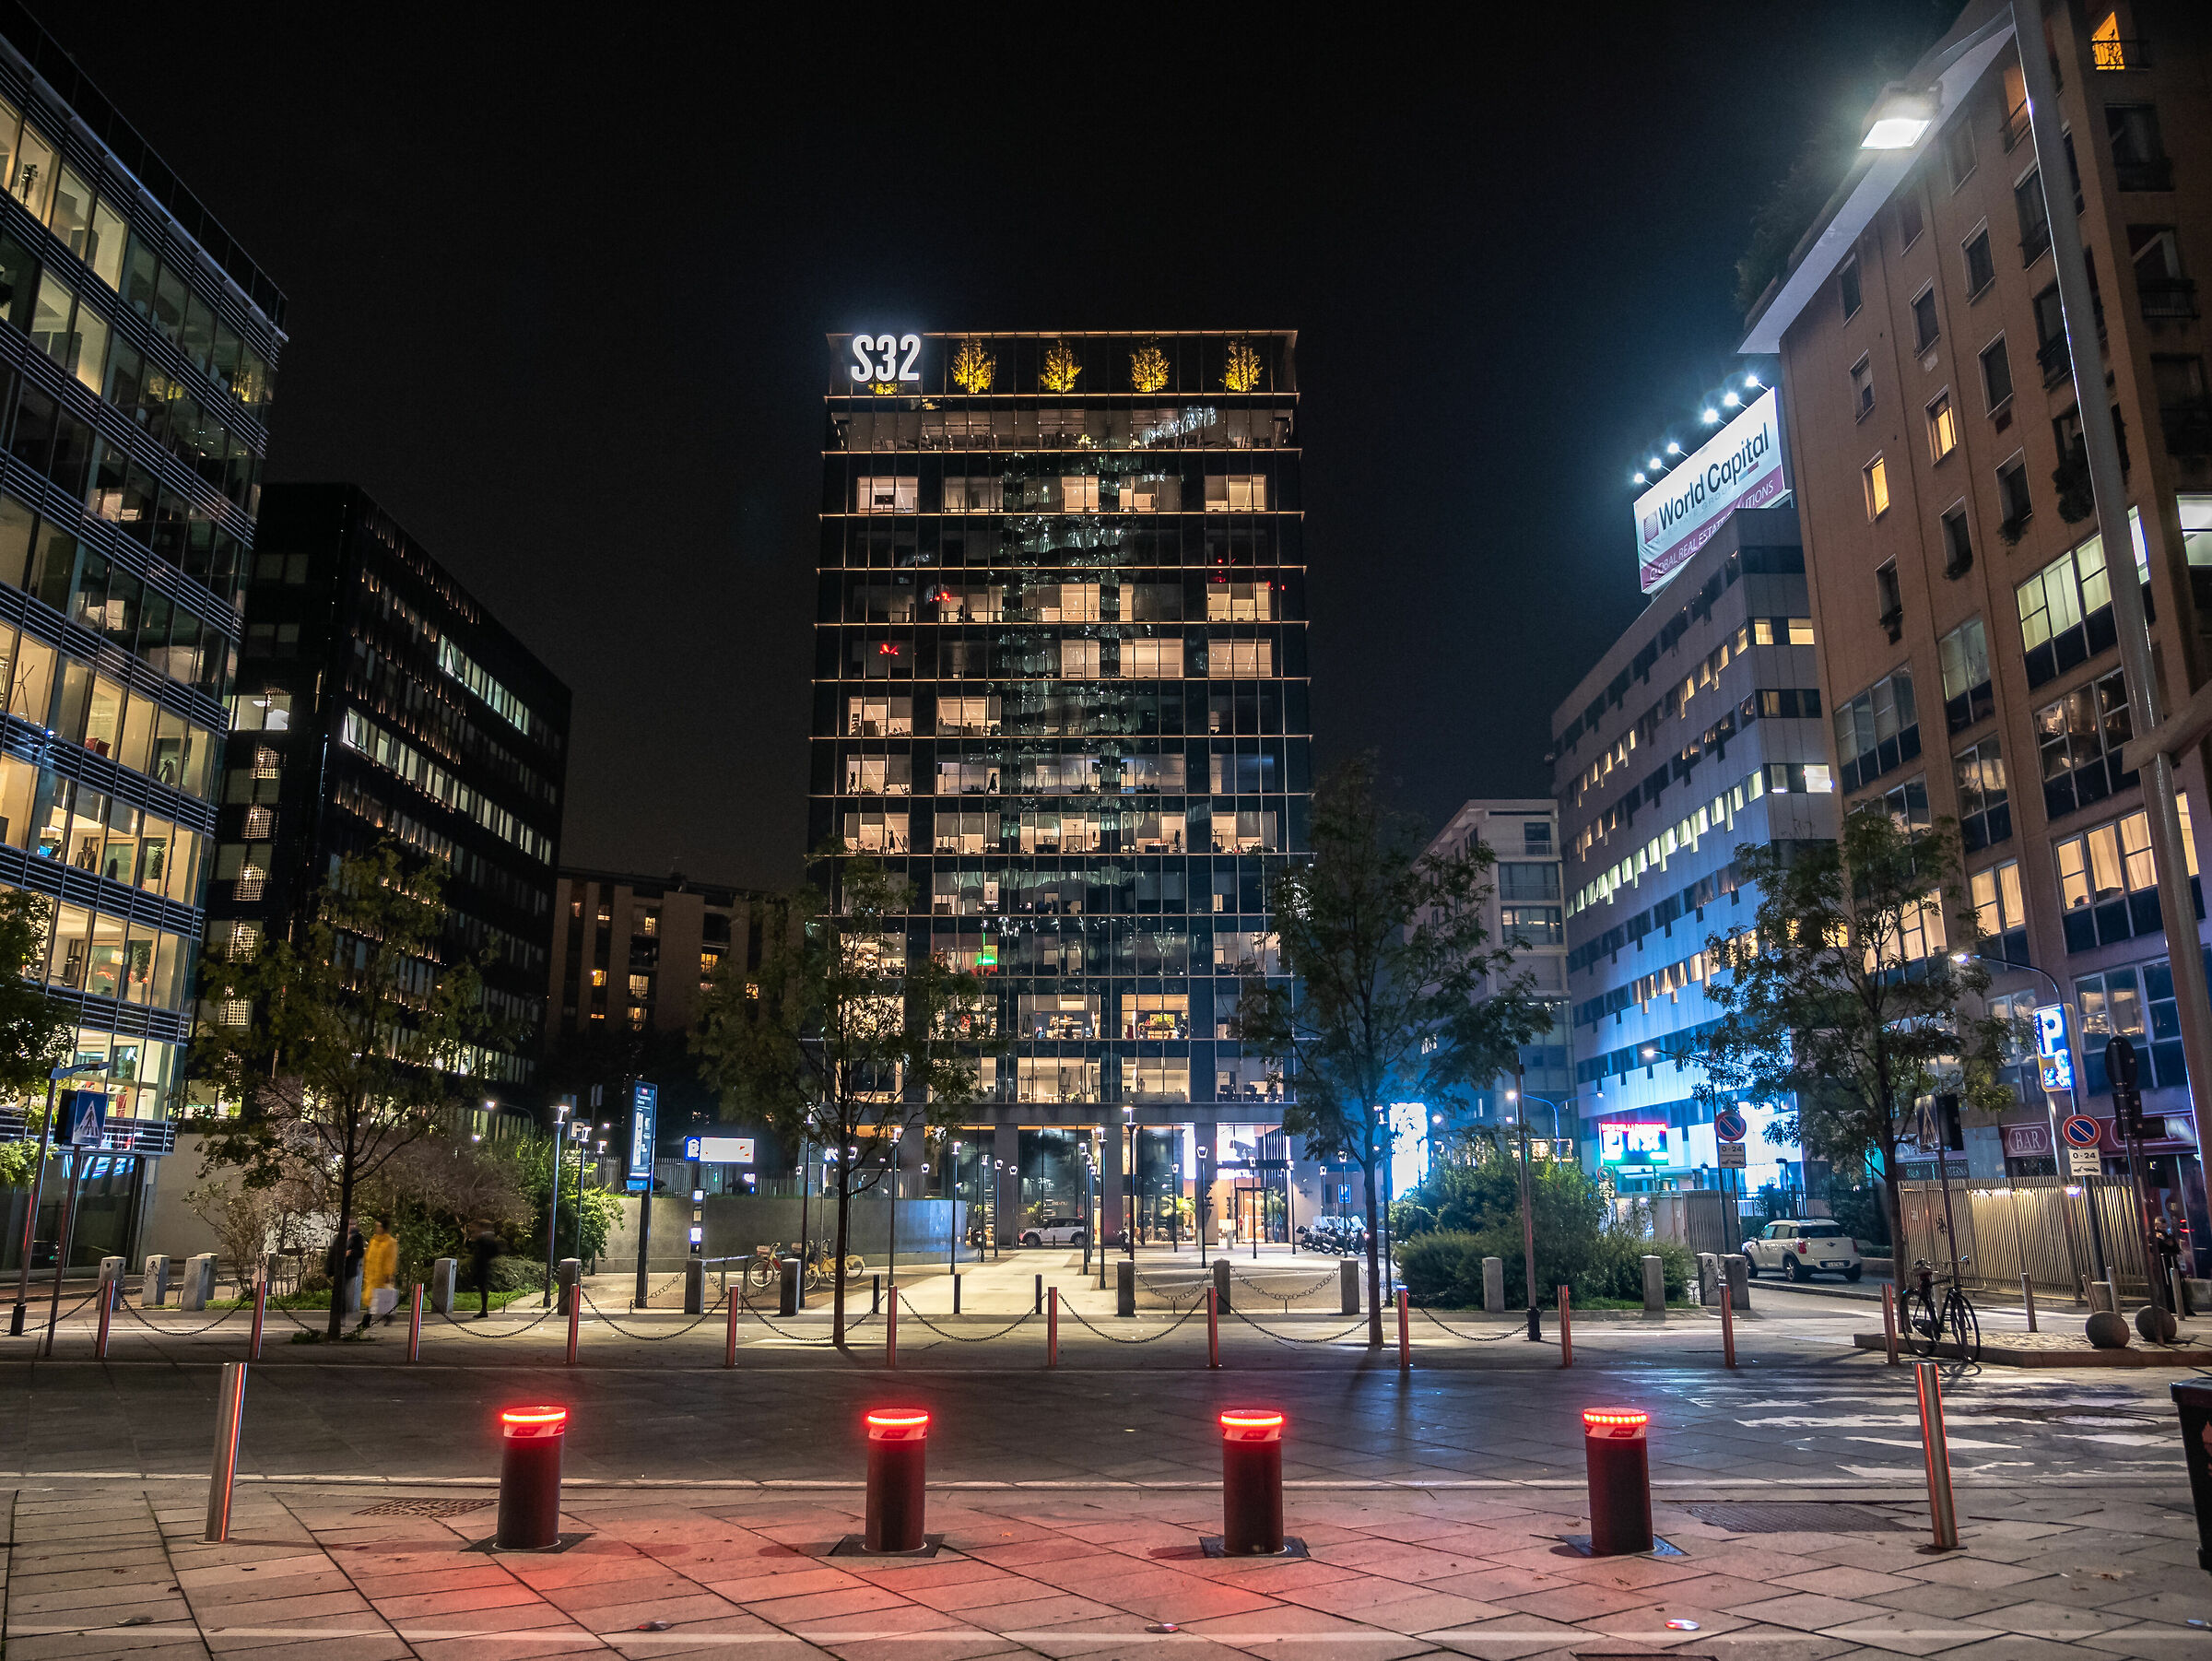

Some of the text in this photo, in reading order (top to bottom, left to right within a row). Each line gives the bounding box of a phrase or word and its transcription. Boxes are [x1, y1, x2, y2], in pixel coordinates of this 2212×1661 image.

[851, 334, 921, 383] S32
[1659, 422, 1770, 530] World Capital
[1678, 539, 1698, 560] REAL
[2015, 1130, 2041, 1150] BAR
